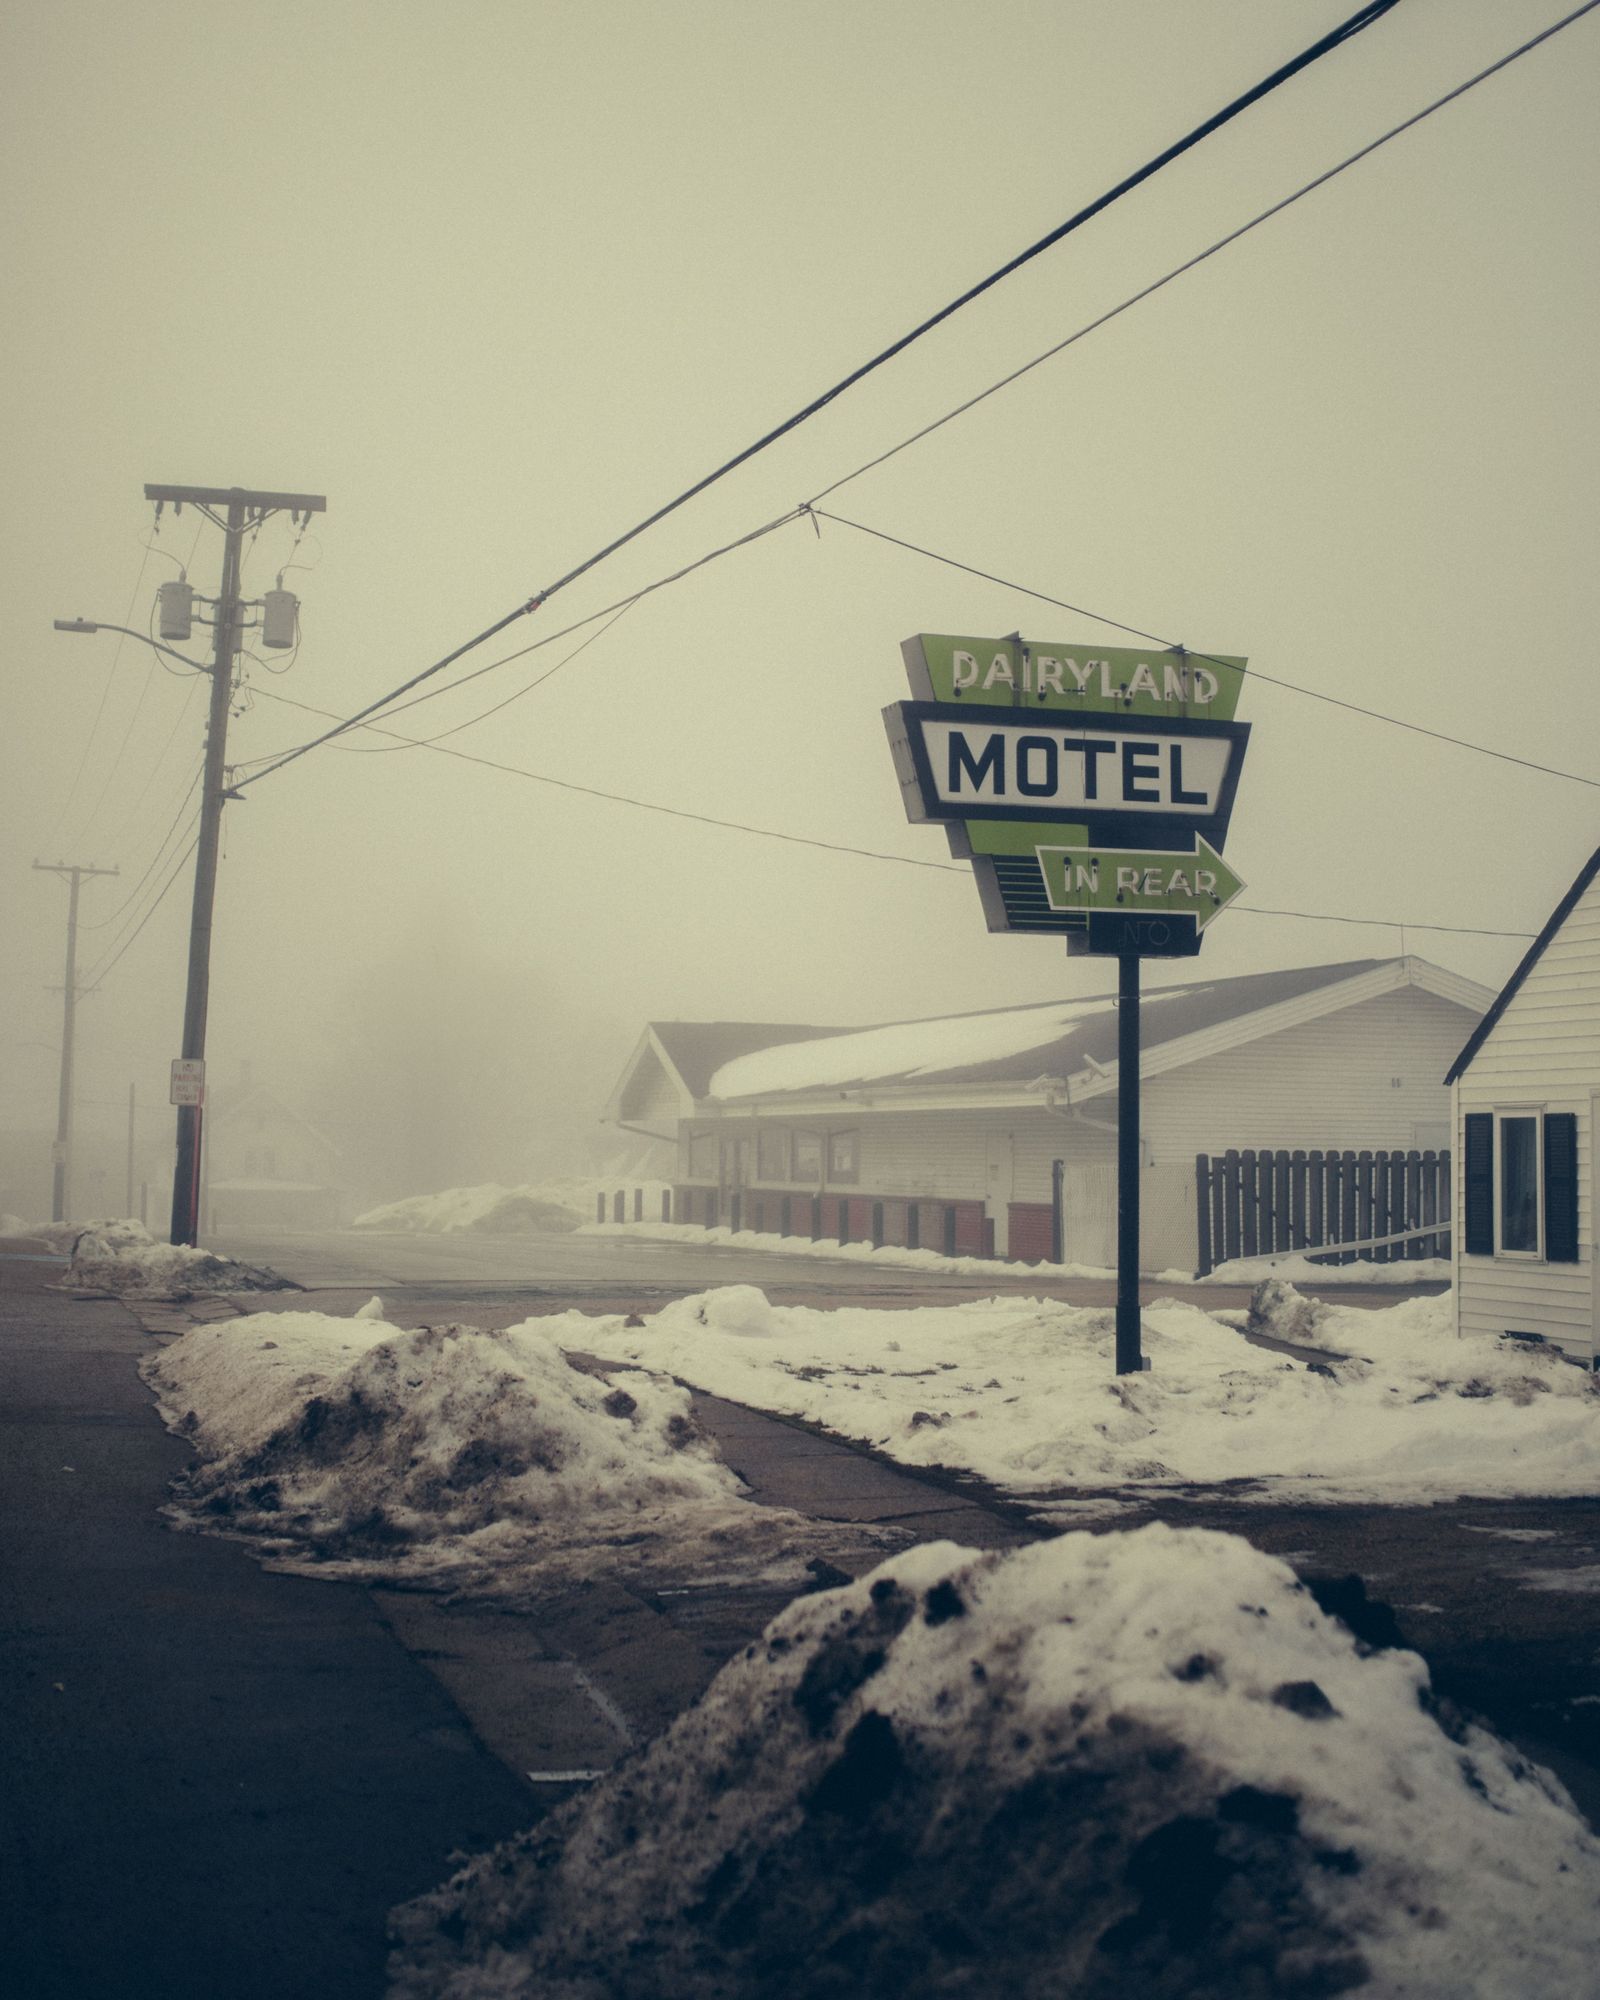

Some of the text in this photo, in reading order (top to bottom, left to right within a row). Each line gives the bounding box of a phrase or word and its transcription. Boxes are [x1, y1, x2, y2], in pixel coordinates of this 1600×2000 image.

[952, 650, 1219, 703] DAIRYLAND
[948, 731, 1208, 805] MOTEL
[1063, 863, 1217, 897] IN REAR
[1119, 920, 1171, 946] NO
